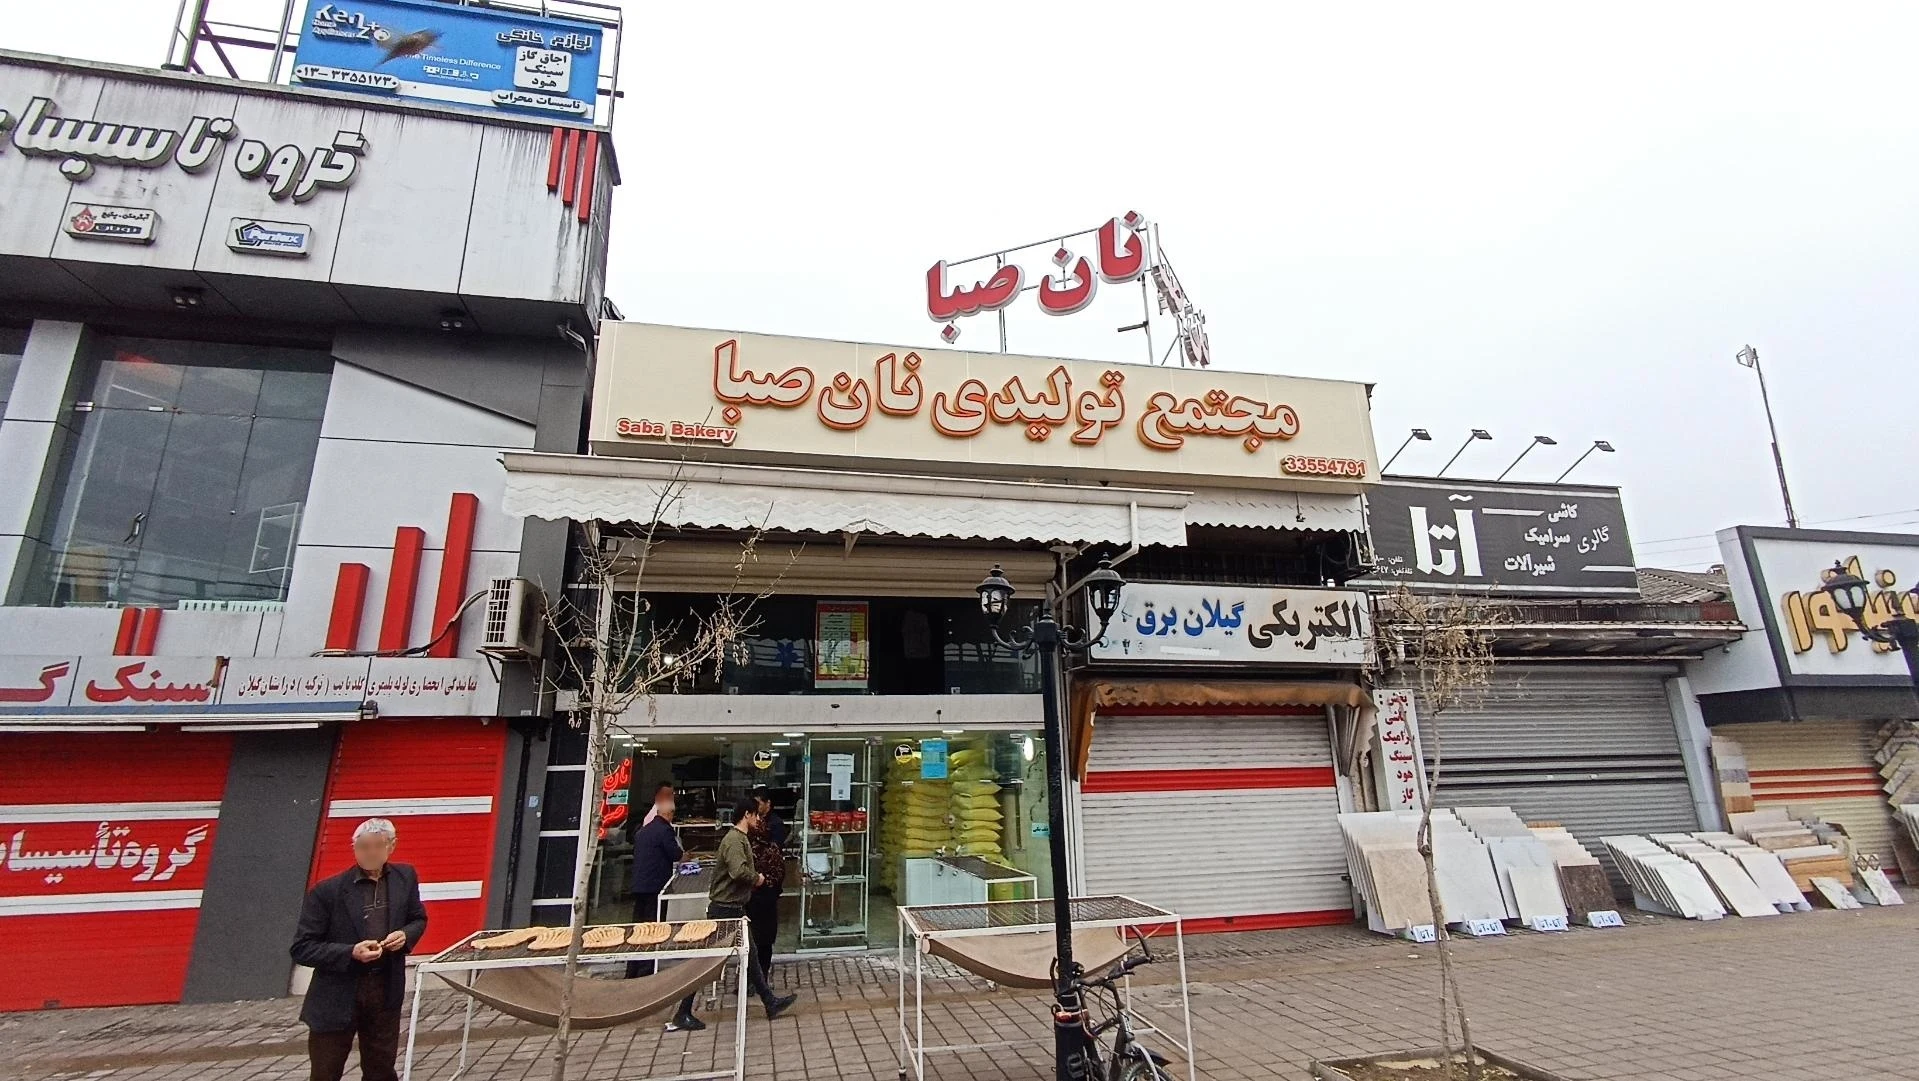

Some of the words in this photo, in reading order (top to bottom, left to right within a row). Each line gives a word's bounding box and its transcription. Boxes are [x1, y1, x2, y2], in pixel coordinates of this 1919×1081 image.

[518, 49, 538, 62] گاز
[549, 33, 593, 51] لوازم
[421, 53, 459, 65] Timeless
[459, 58, 502, 71] Difference
[524, 64, 564, 78] سینک
[539, 53, 567, 66] اجاق
[531, 77, 558, 89] هود
[497, 92, 534, 104] محراب
[536, 97, 581, 110] تاسیسات
[234, 130, 370, 205] گروه
[1038, 210, 1149, 317] نان
[926, 259, 1026, 345] صبا
[712, 338, 816, 426] صبا
[817, 351, 925, 431] نان
[929, 365, 1126, 446] تولیدی
[616, 418, 666, 438] Saba
[669, 421, 738, 446] Bakery
[1136, 388, 1302, 453] مجتمع
[1281, 455, 1367, 477] 33554791
[1547, 503, 1579, 523] کاشی
[1408, 493, 1484, 577] آتا
[1524, 527, 1572, 548] سرامیک
[1577, 526, 1610, 554] گالری
[1135, 601, 1178, 636] برق
[1183, 598, 1245, 637] گیلان
[1247, 599, 1362, 650] الکتریکی
[1382, 731, 1415, 745] رامیک
[603, 757, 633, 793] نان
[1396, 769, 1414, 782] هود
[118, 823, 210, 882] گروه
